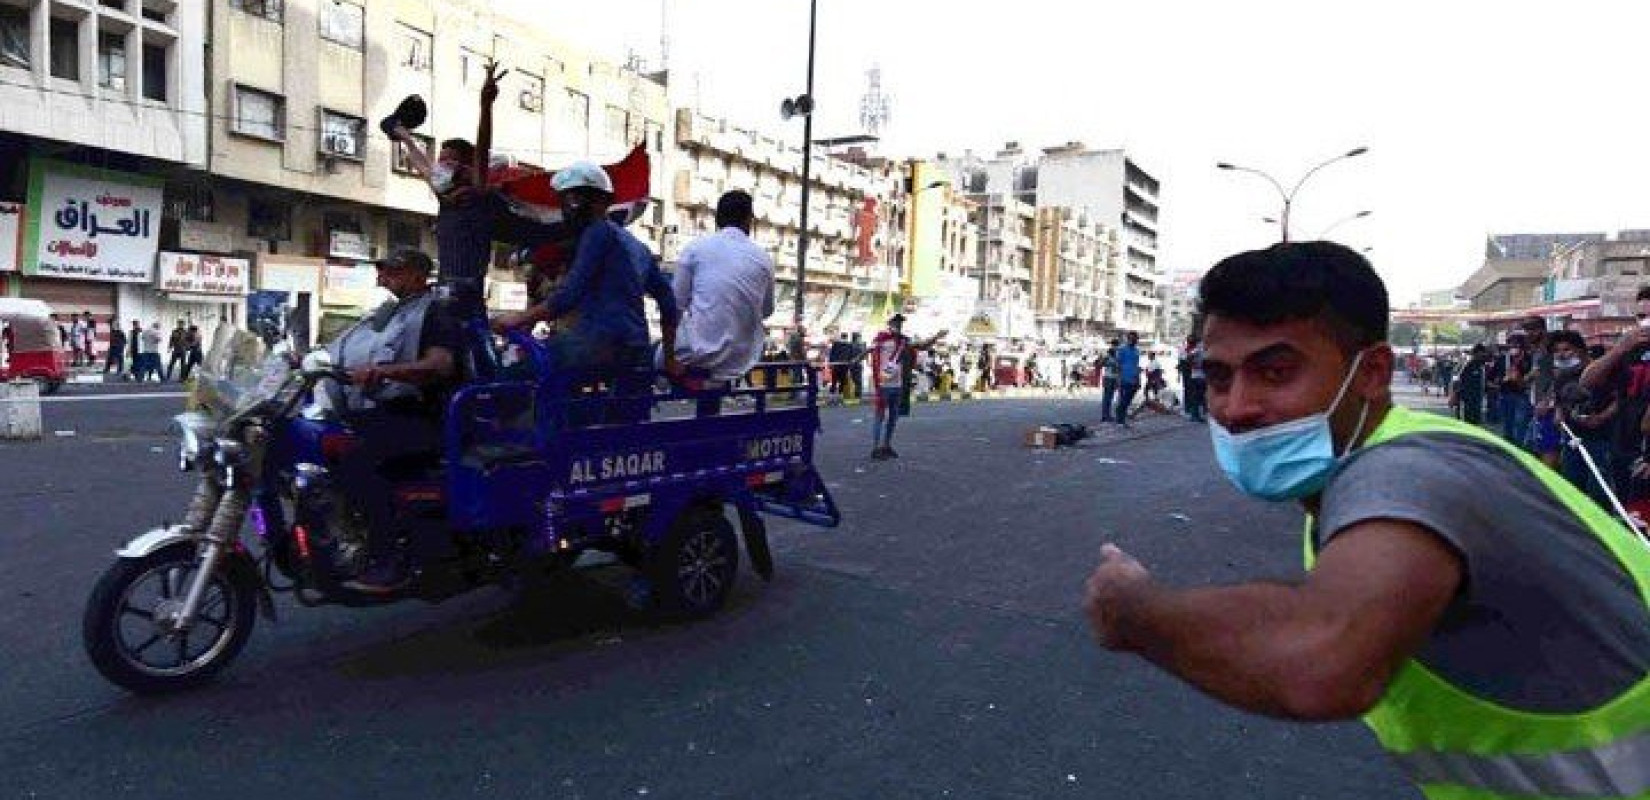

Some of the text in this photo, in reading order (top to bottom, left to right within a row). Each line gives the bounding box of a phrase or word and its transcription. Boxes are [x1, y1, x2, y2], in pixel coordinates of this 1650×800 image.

[55, 197, 150, 238] العراق
[570, 434, 803, 484] AL SAQAR MOTOR
